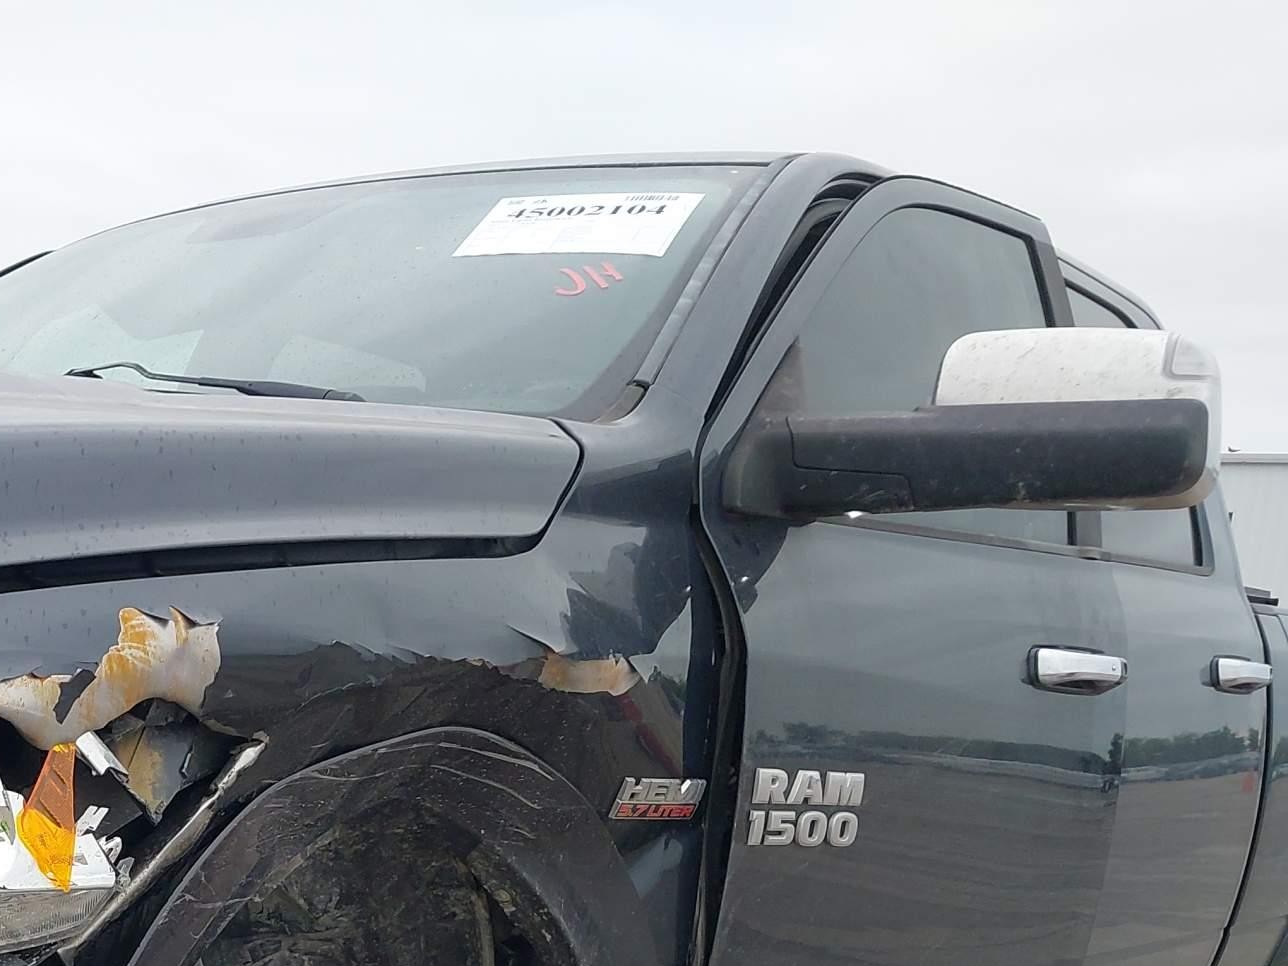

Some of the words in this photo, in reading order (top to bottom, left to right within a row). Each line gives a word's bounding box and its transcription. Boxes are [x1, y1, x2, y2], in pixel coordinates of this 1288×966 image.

[507, 204, 667, 218] 45002104
[752, 767, 865, 806] RAM
[616, 803, 649, 817] 5.7
[647, 803, 695, 817] LITER
[748, 809, 858, 847] 1500
